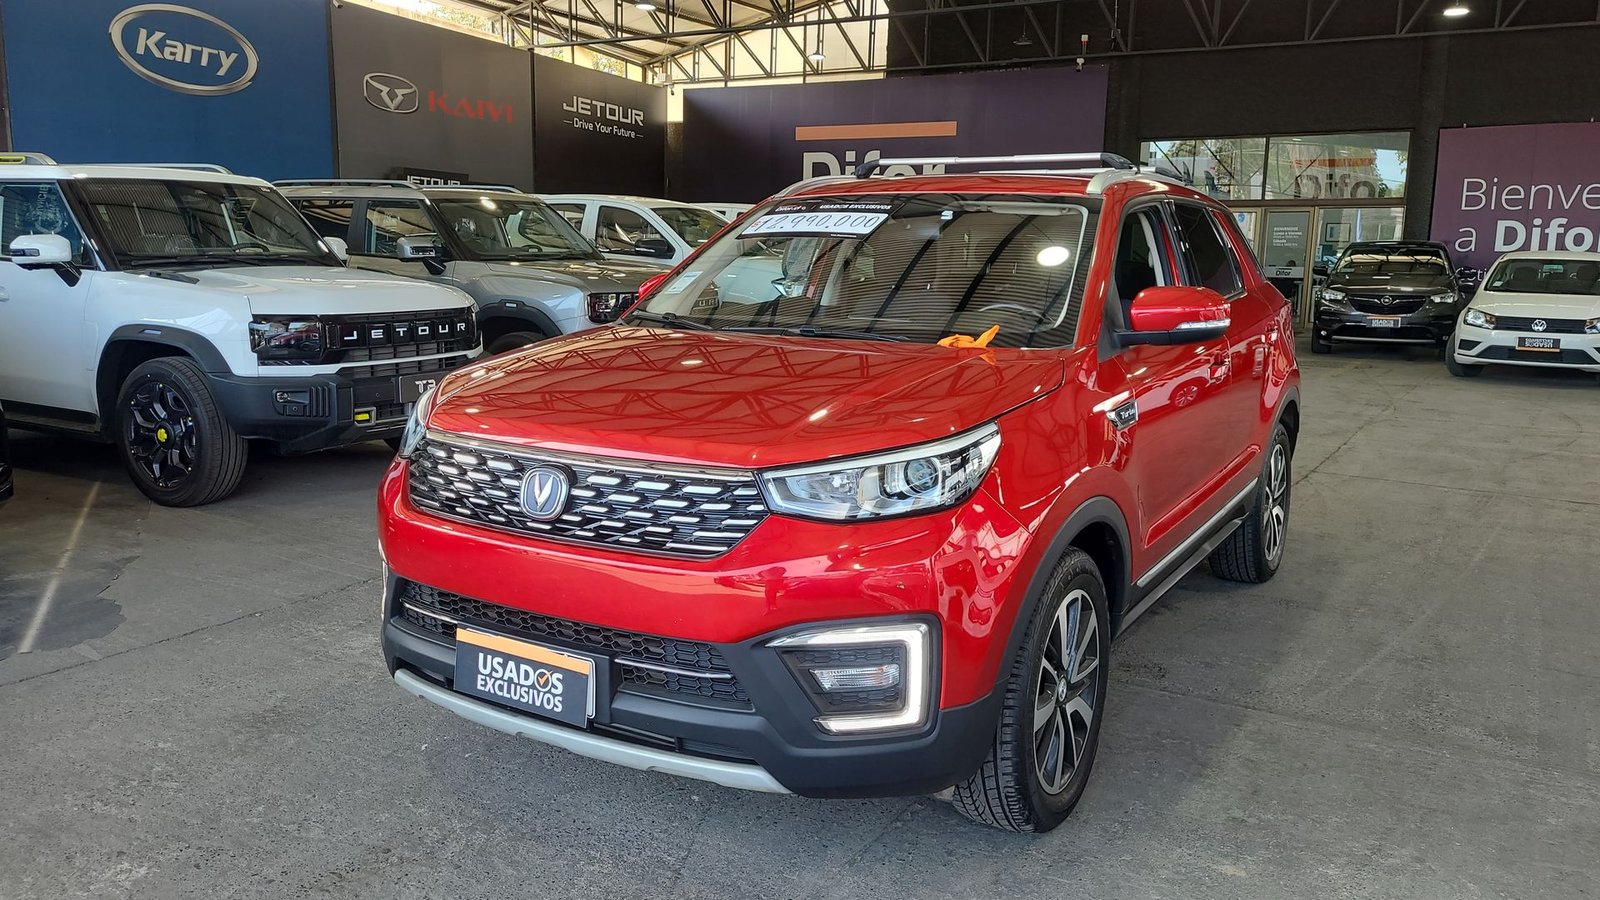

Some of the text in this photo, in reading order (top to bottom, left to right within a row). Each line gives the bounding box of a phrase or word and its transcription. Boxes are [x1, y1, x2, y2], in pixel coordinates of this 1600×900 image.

[136, 27, 239, 76] Karry
[563, 95, 644, 126] JETOUR
[573, 117, 636, 138] Drive Your Future
[1461, 177, 1600, 210] Bienve
[1454, 217, 1600, 252] a Difo
[343, 322, 466, 340] JETOUR
[478, 652, 564, 695] USADOS
[476, 674, 563, 712] EXCLUSIVOS
